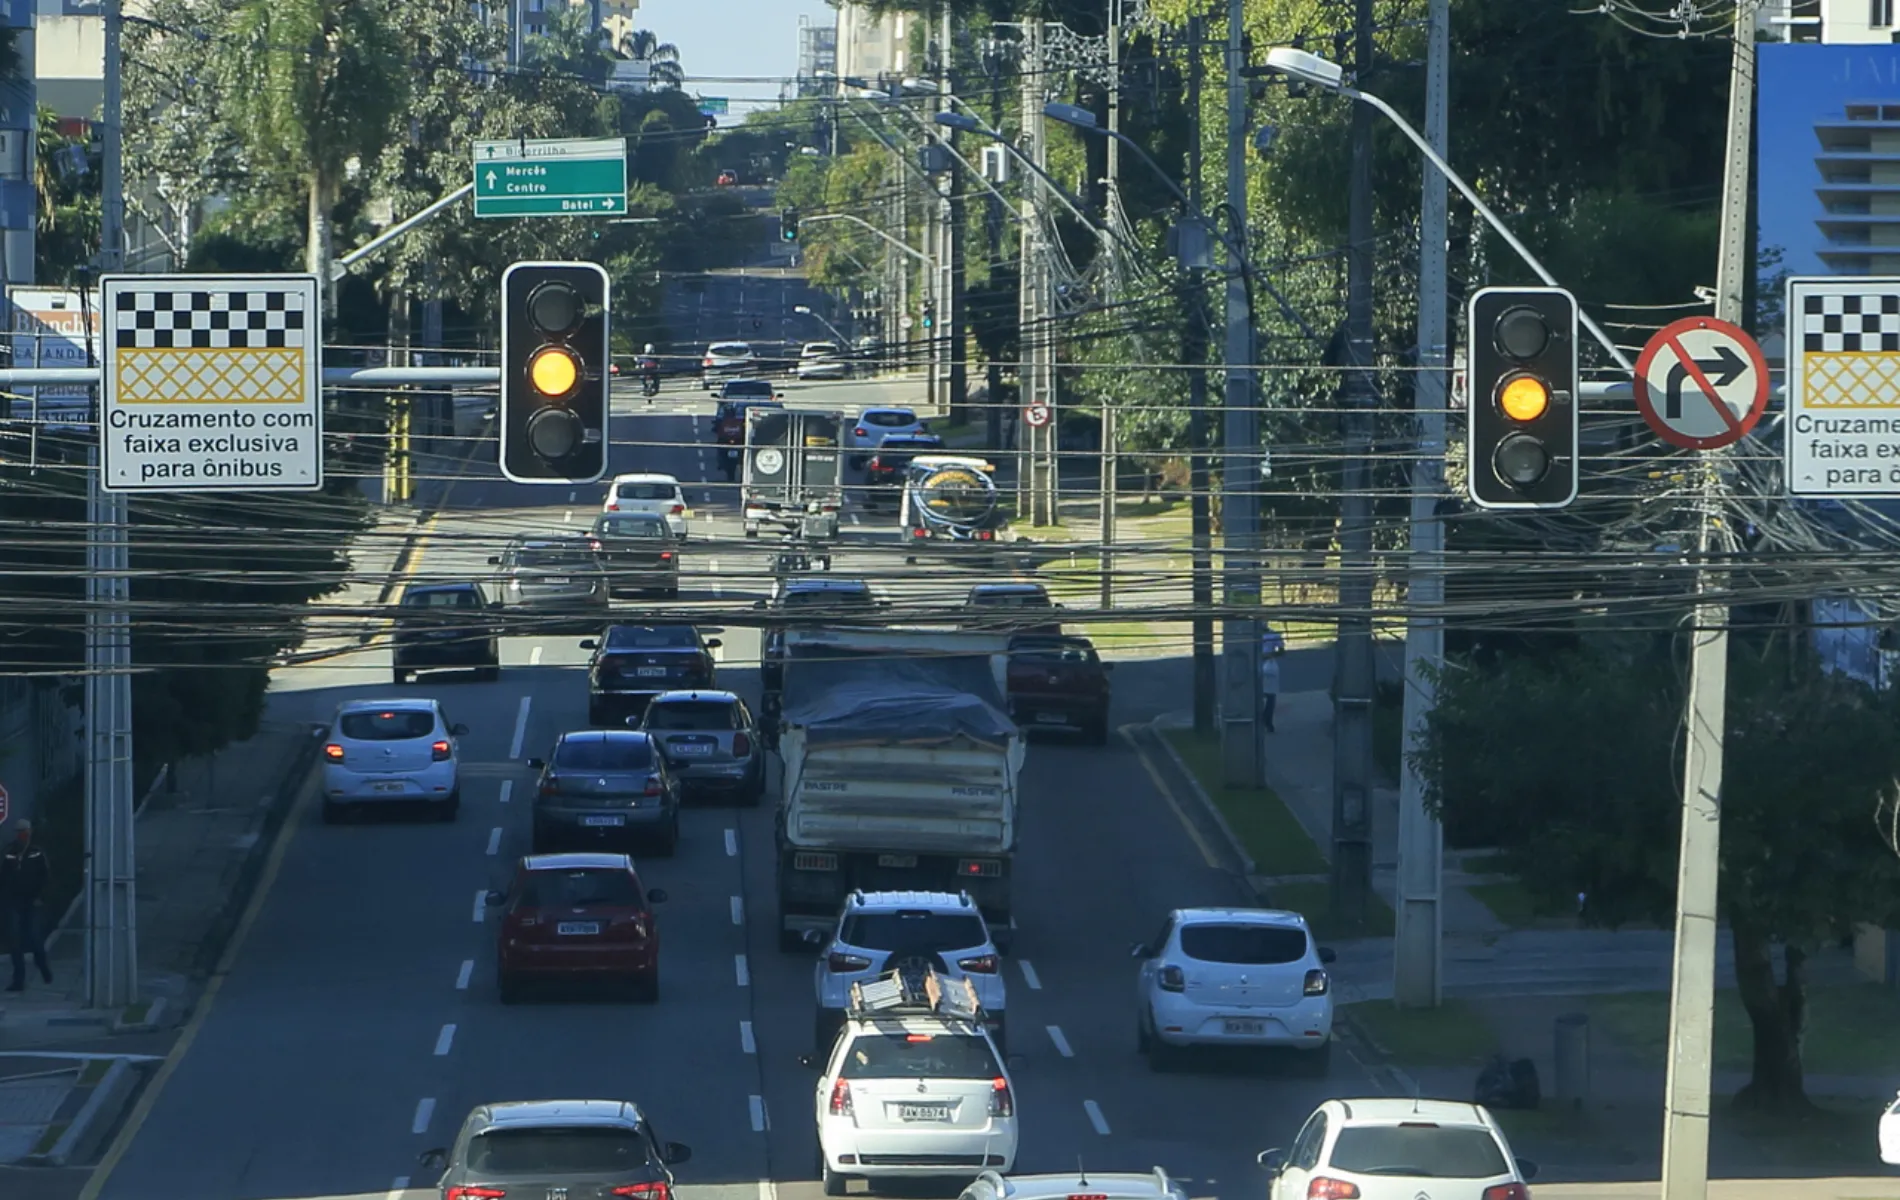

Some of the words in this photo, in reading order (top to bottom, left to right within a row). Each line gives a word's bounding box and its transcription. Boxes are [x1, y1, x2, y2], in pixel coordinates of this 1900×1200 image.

[1831, 56, 1900, 83] JA
[506, 165, 547, 177] Mercês
[506, 183, 547, 193] Centro
[562, 200, 593, 210] Batel
[110, 409, 256, 429] Cruzamento
[263, 413, 313, 428] com
[124, 434, 181, 453] faixa
[188, 434, 299, 453] exclusiva
[1810, 439, 1868, 458] faixa
[141, 463, 195, 482] para
[203, 458, 283, 477] ônibus
[1827, 468, 1881, 488] para
